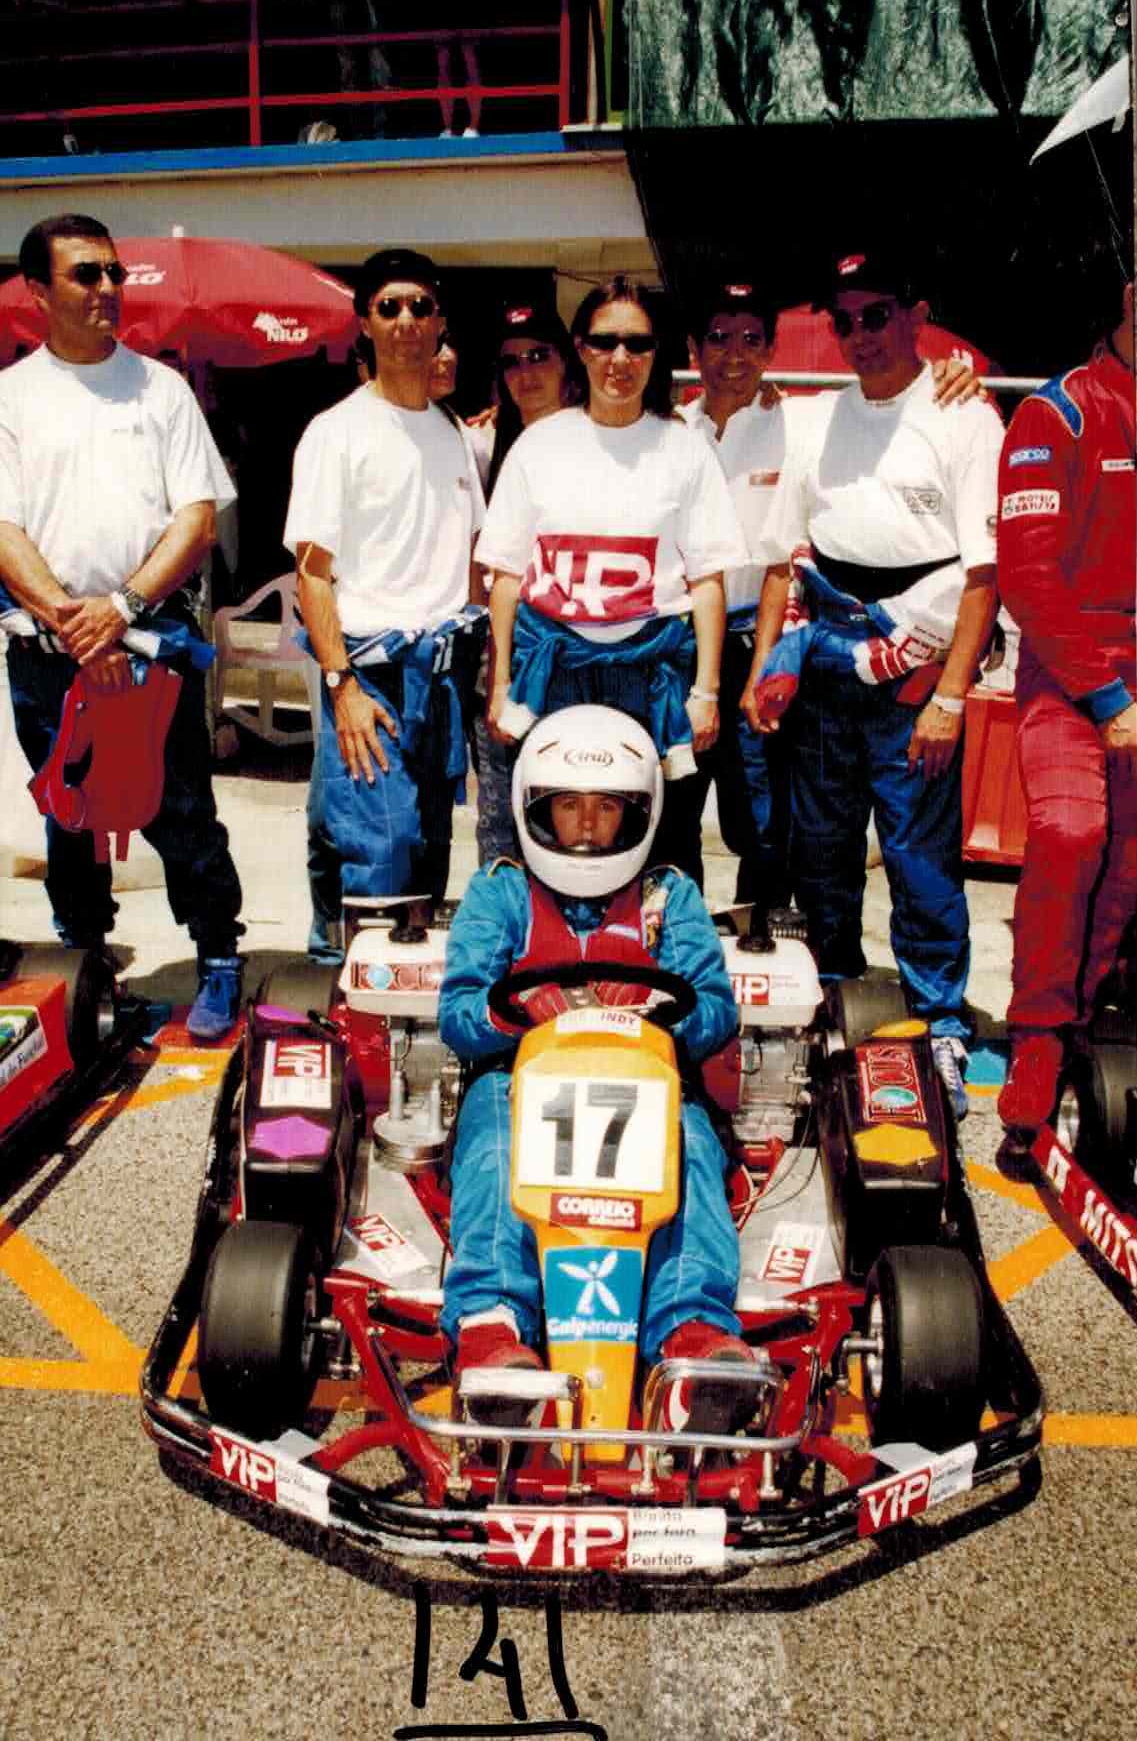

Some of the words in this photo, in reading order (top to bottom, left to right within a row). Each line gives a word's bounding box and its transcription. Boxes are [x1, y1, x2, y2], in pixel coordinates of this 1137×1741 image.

[276, 1044, 322, 1078] VIP
[542, 1082, 638, 1178] 17
[213, 1435, 275, 1492] VIP
[867, 1474, 930, 1528] VIP
[499, 1514, 625, 1567] VIP
